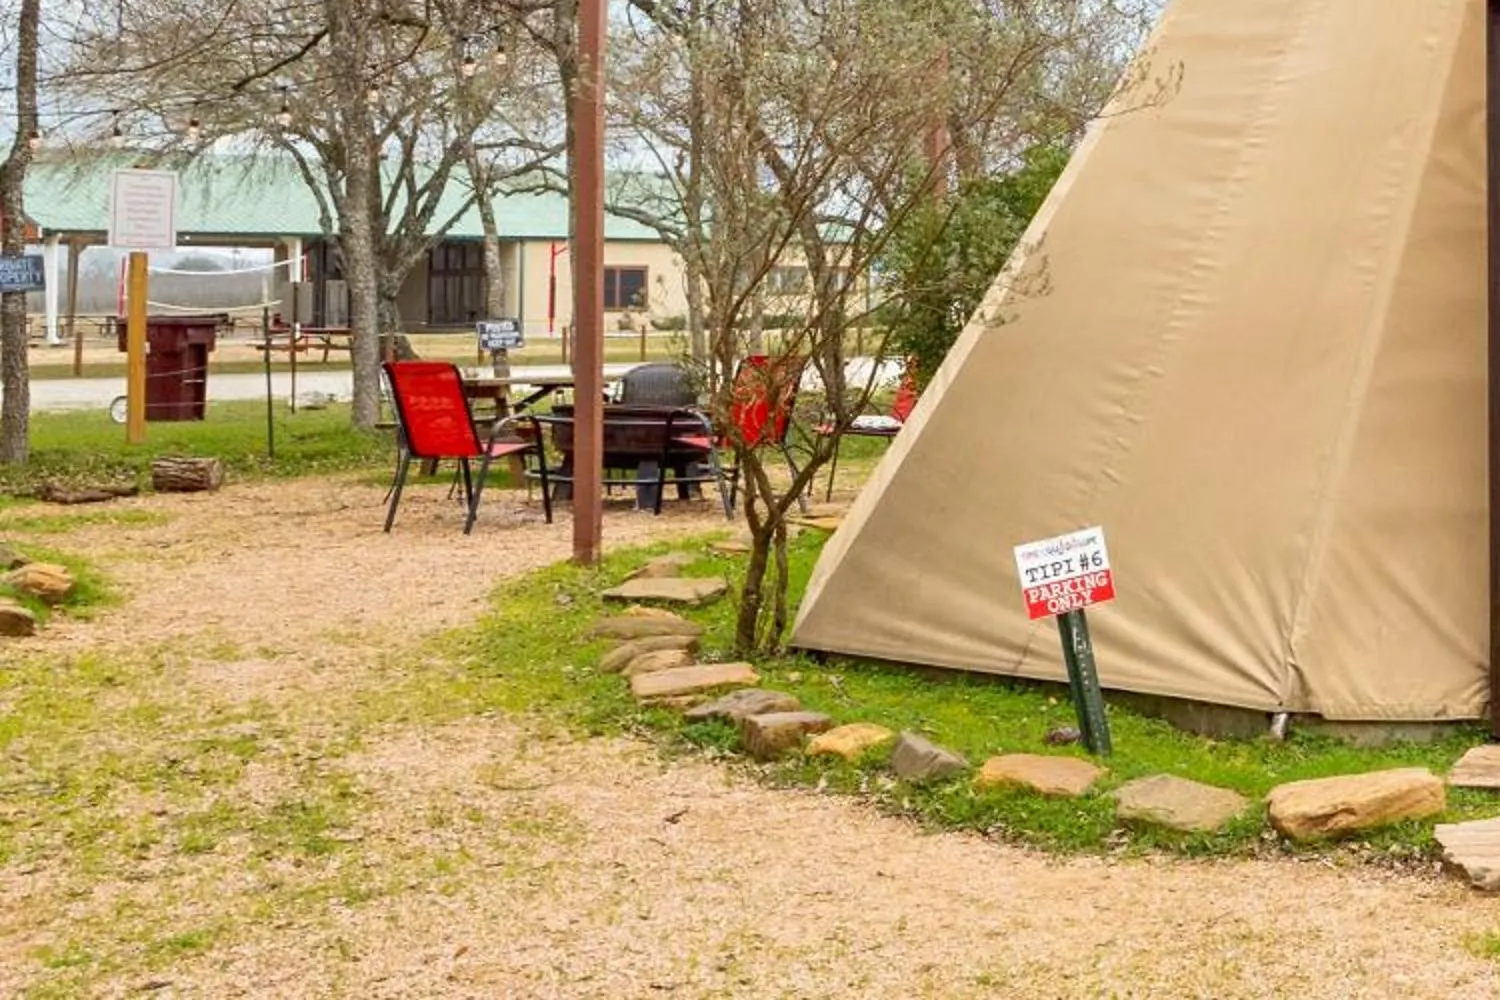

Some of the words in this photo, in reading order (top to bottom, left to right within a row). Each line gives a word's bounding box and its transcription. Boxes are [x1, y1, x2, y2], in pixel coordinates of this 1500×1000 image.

[1026, 559, 1075, 583] TIPI
[1079, 551, 1103, 571] #6
[1028, 572, 1109, 604] PARKING
[1047, 589, 1093, 613] ONLY
